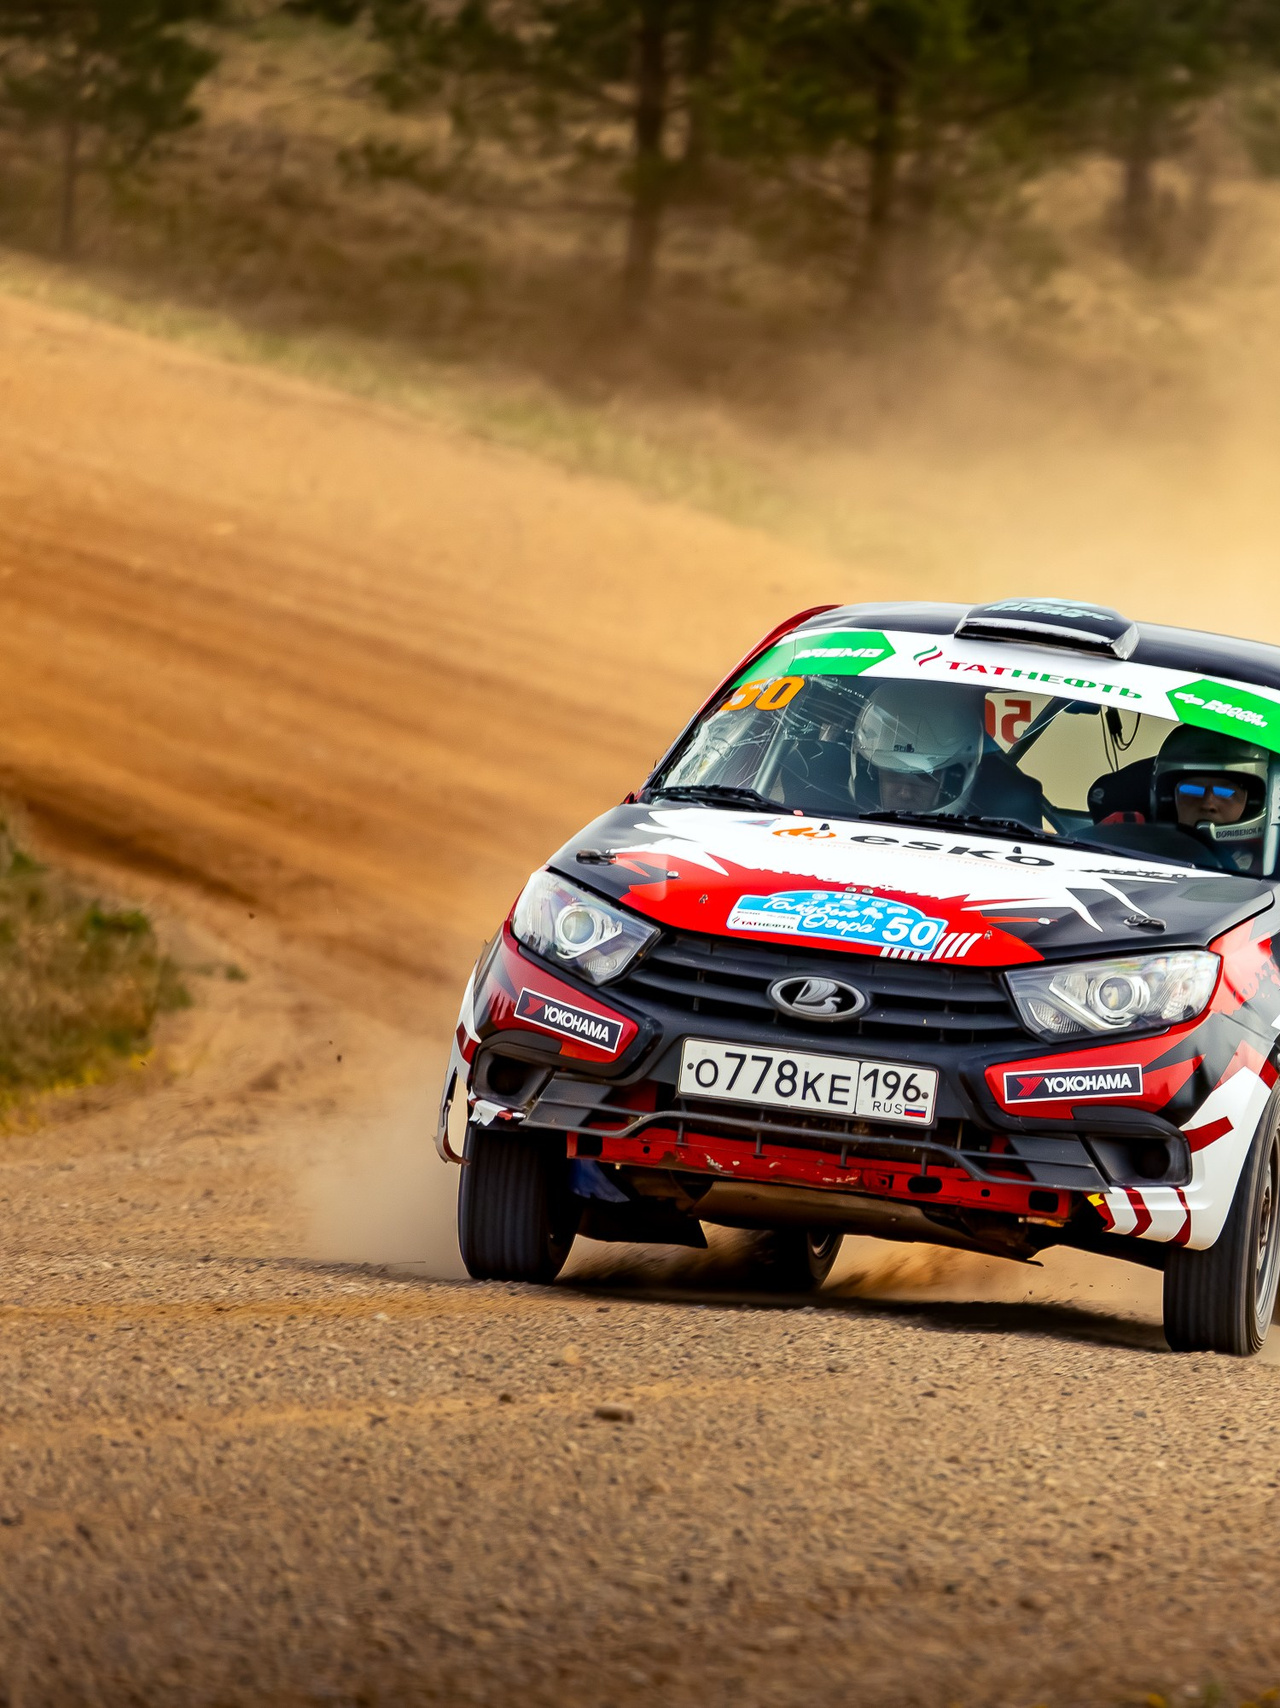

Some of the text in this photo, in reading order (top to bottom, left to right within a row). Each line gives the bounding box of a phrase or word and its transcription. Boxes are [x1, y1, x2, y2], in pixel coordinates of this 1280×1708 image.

[720, 676, 805, 711] 50
[946, 661, 1142, 699] ТАТНЕФТЬ
[850, 835, 1055, 867] esko
[882, 917, 939, 947] 50
[544, 1004, 609, 1042] YOKOHAMA
[863, 1068, 922, 1103] 196
[1045, 1073, 1132, 1093] YOKOHAMA
[872, 1101, 903, 1115] RUS
